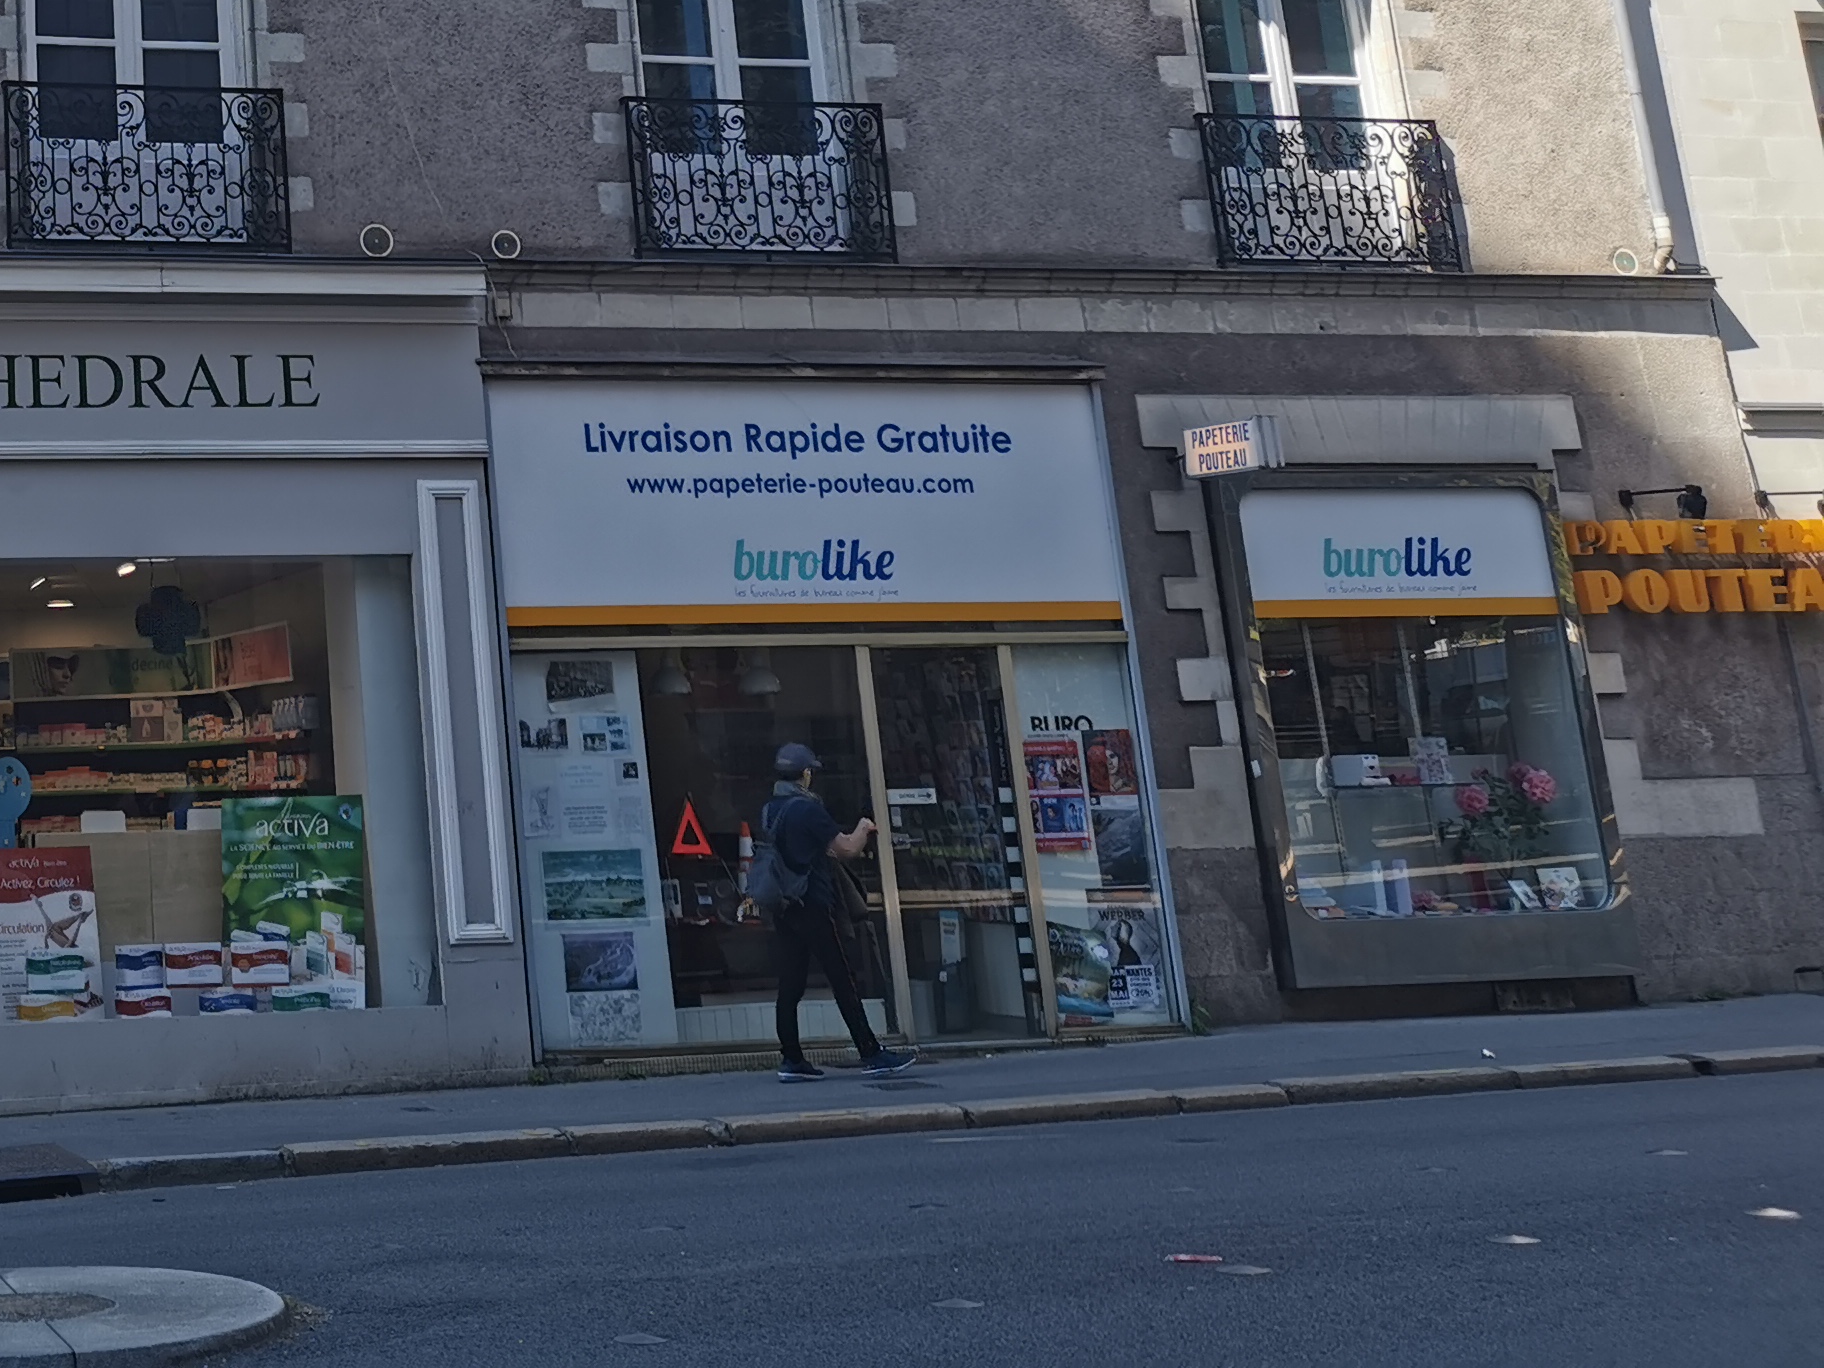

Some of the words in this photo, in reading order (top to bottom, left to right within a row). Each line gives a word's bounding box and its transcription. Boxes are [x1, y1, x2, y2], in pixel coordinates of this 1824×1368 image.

[583, 423, 733, 454] Livraison
[745, 423, 866, 460] Rapide
[876, 423, 1012, 455] Gratuite
[1191, 422, 1250, 449] PAPETERIE
[1198, 448, 1247, 472] POUTEAU
[626, 472, 975, 499] www.papeterie-pouteau.com
[733, 538, 895, 581] burolike
[1323, 536, 1472, 578] burolike
[256, 812, 329, 838] activa
[9, 856, 40, 869] activa
[37, 876, 74, 888] Circulez
[1097, 909, 1146, 921] WERBER
